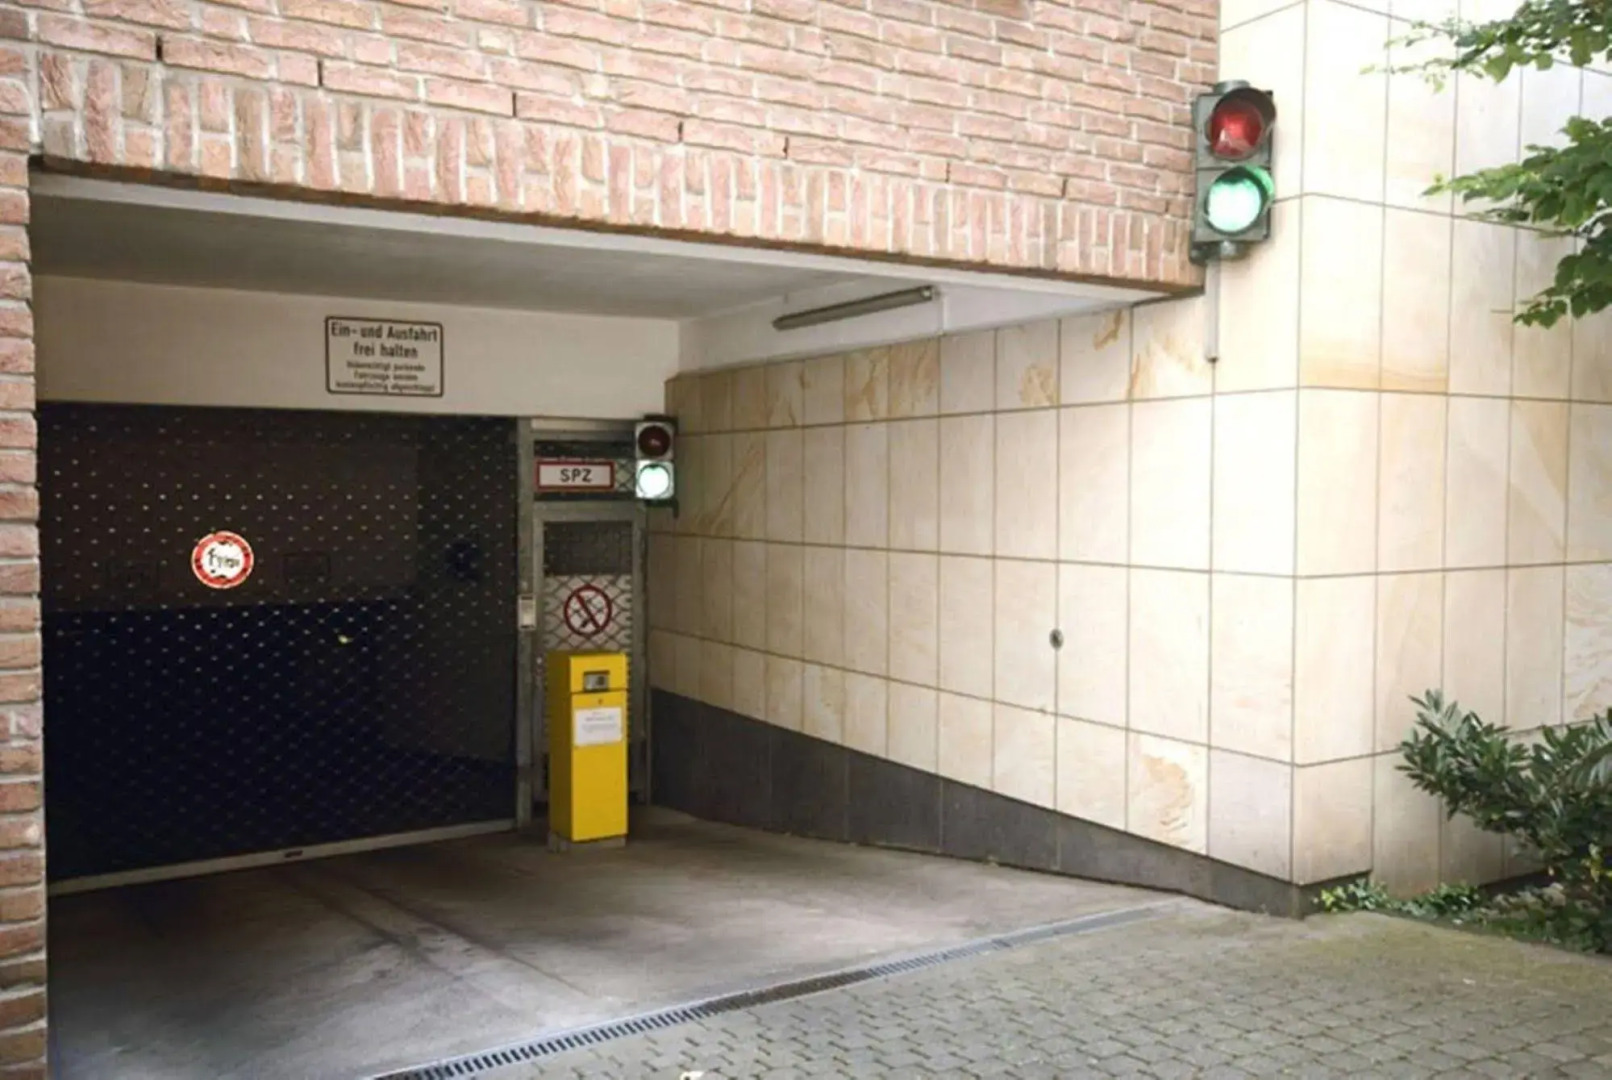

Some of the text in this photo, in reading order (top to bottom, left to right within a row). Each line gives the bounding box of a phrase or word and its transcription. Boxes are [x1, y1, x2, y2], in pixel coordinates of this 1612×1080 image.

[331, 321, 437, 342] Ein- und Ausfahrt
[353, 341, 418, 359] frei halten
[560, 467, 592, 483] SPZ
